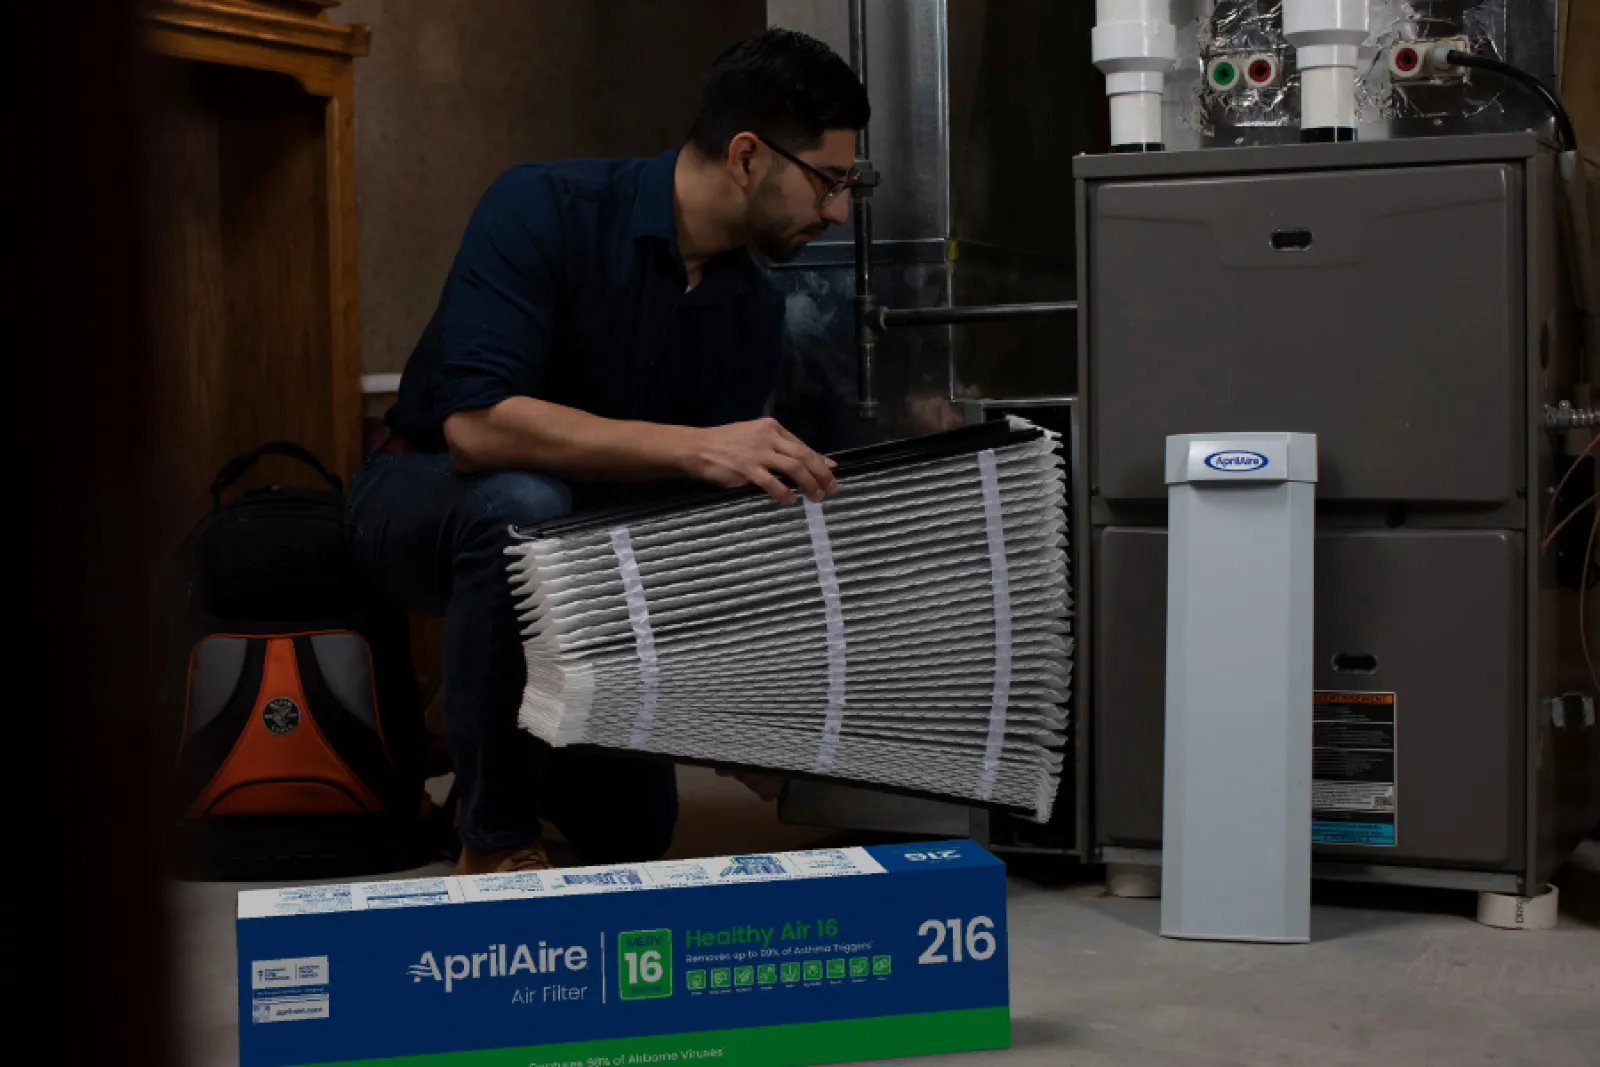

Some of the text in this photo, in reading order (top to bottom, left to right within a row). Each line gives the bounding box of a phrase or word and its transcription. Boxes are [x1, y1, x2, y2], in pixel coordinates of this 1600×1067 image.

[1216, 456, 1260, 468] AprilAire
[626, 935, 664, 948] MERV
[686, 919, 838, 948] Healthy Air 16
[917, 915, 996, 964] 216
[686, 953, 731, 963] Removes
[734, 949, 745, 961] up
[747, 949, 758, 958] to
[782, 946, 791, 955] of
[794, 943, 831, 954] Asthma
[407, 941, 588, 992] AprilAire
[624, 950, 663, 984] 16
[512, 984, 588, 1004] Air Filter
[628, 1053, 678, 1064] Airborne
